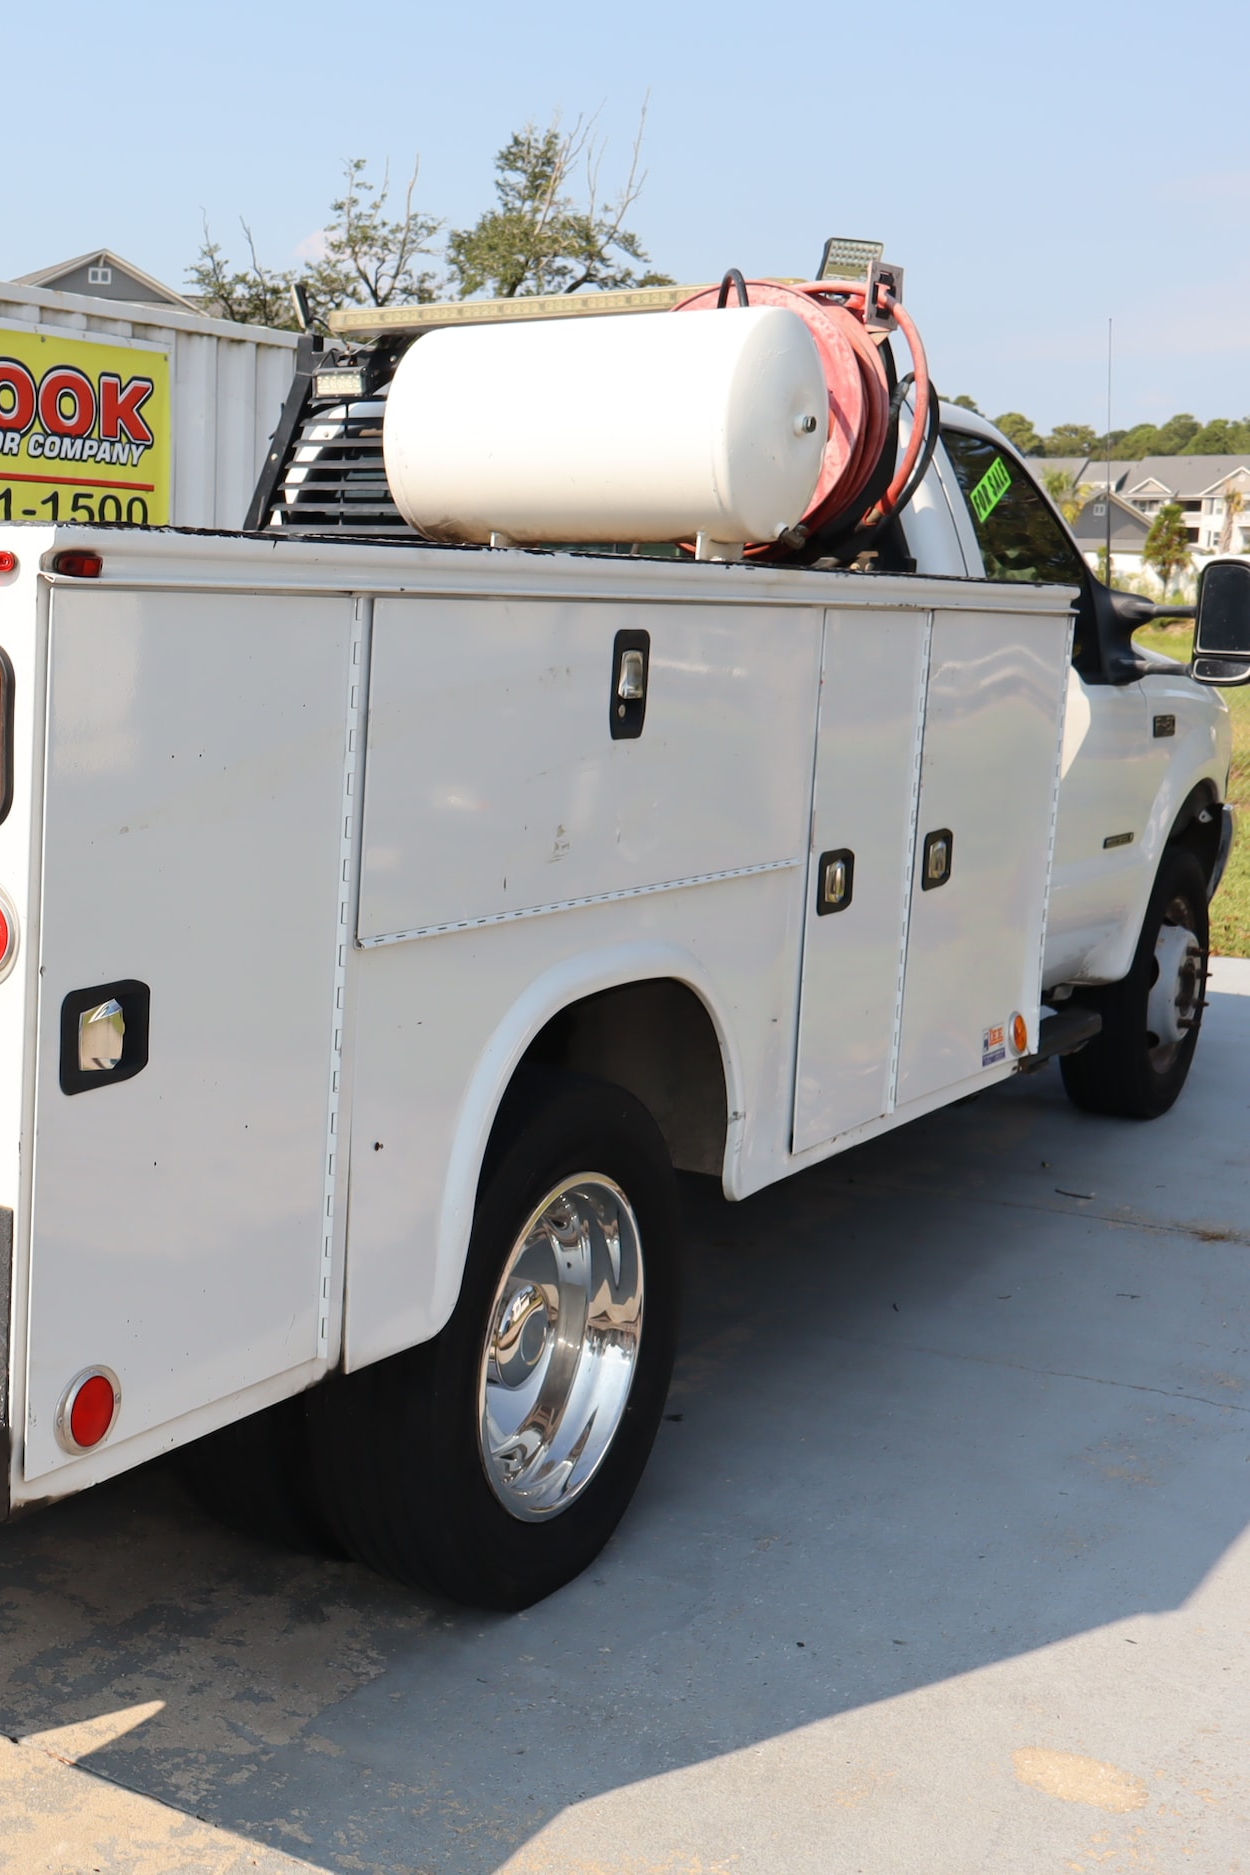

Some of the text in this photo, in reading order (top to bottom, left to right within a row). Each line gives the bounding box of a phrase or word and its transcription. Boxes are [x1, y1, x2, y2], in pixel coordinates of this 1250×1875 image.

[27, 432, 146, 468] COMPANY
[972, 460, 1010, 519] FOR SALE
